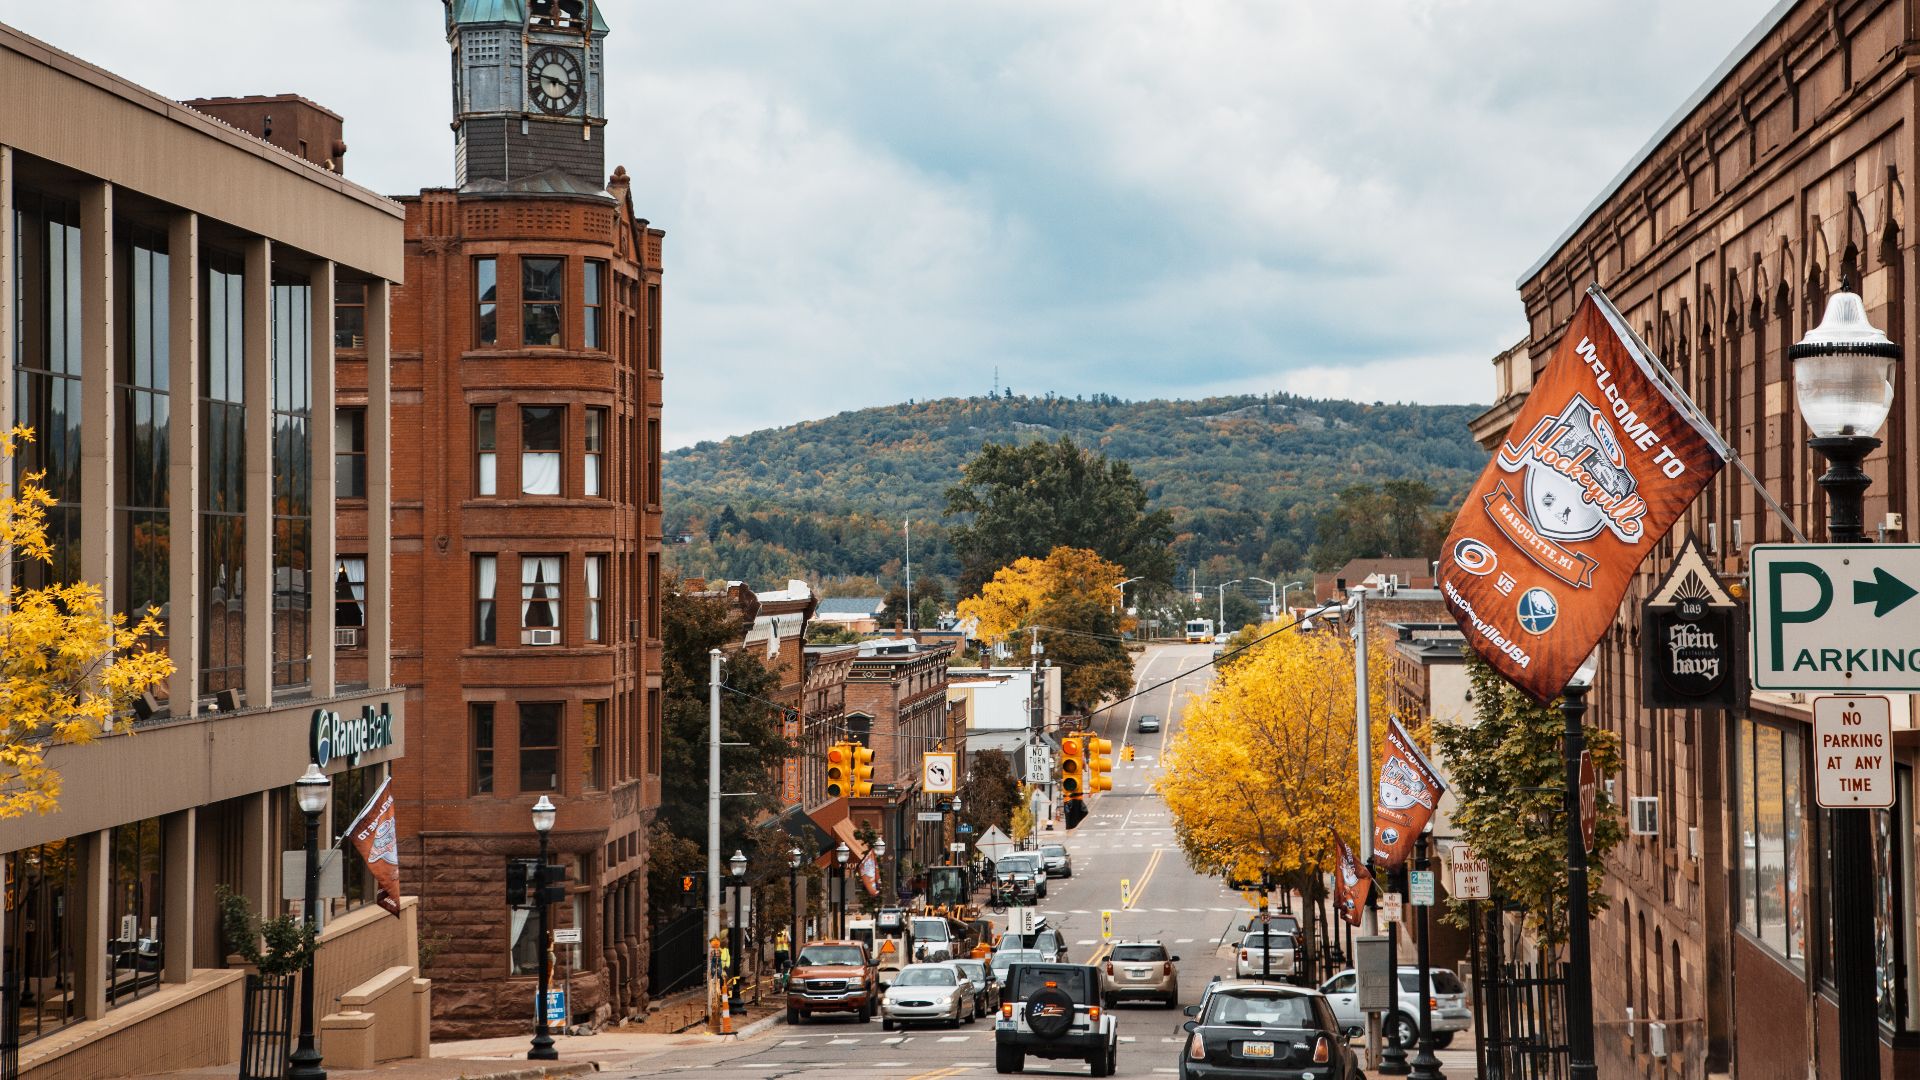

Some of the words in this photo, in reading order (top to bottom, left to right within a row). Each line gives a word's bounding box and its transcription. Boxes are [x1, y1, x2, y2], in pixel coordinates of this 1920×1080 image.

[1575, 336, 1660, 452] WELCOME
[1652, 444, 1686, 479] TO
[1598, 424, 1615, 456] Kraft
[1501, 418, 1647, 534] Hockeyville
[1497, 575, 1516, 594] VS
[1682, 601, 1702, 615] das
[1667, 623, 1718, 650] Stein
[1842, 711, 1862, 725] NO
[1823, 734, 1883, 748] PARKING
[1033, 747, 1043, 757] NO
[1029, 756, 1046, 765] TURN
[1388, 733, 1428, 777] WELCOME
[1428, 775, 1439, 789] TO
[1826, 756, 1842, 770] AT
[1855, 756, 1882, 770] ANY
[1032, 773, 1045, 781] RED
[1839, 778, 1872, 792] TIME
[1581, 782, 1595, 821] STOP
[1454, 862, 1487, 873] PARKING
[1464, 876, 1479, 884] ANY
[1463, 886, 1480, 894] TIME
